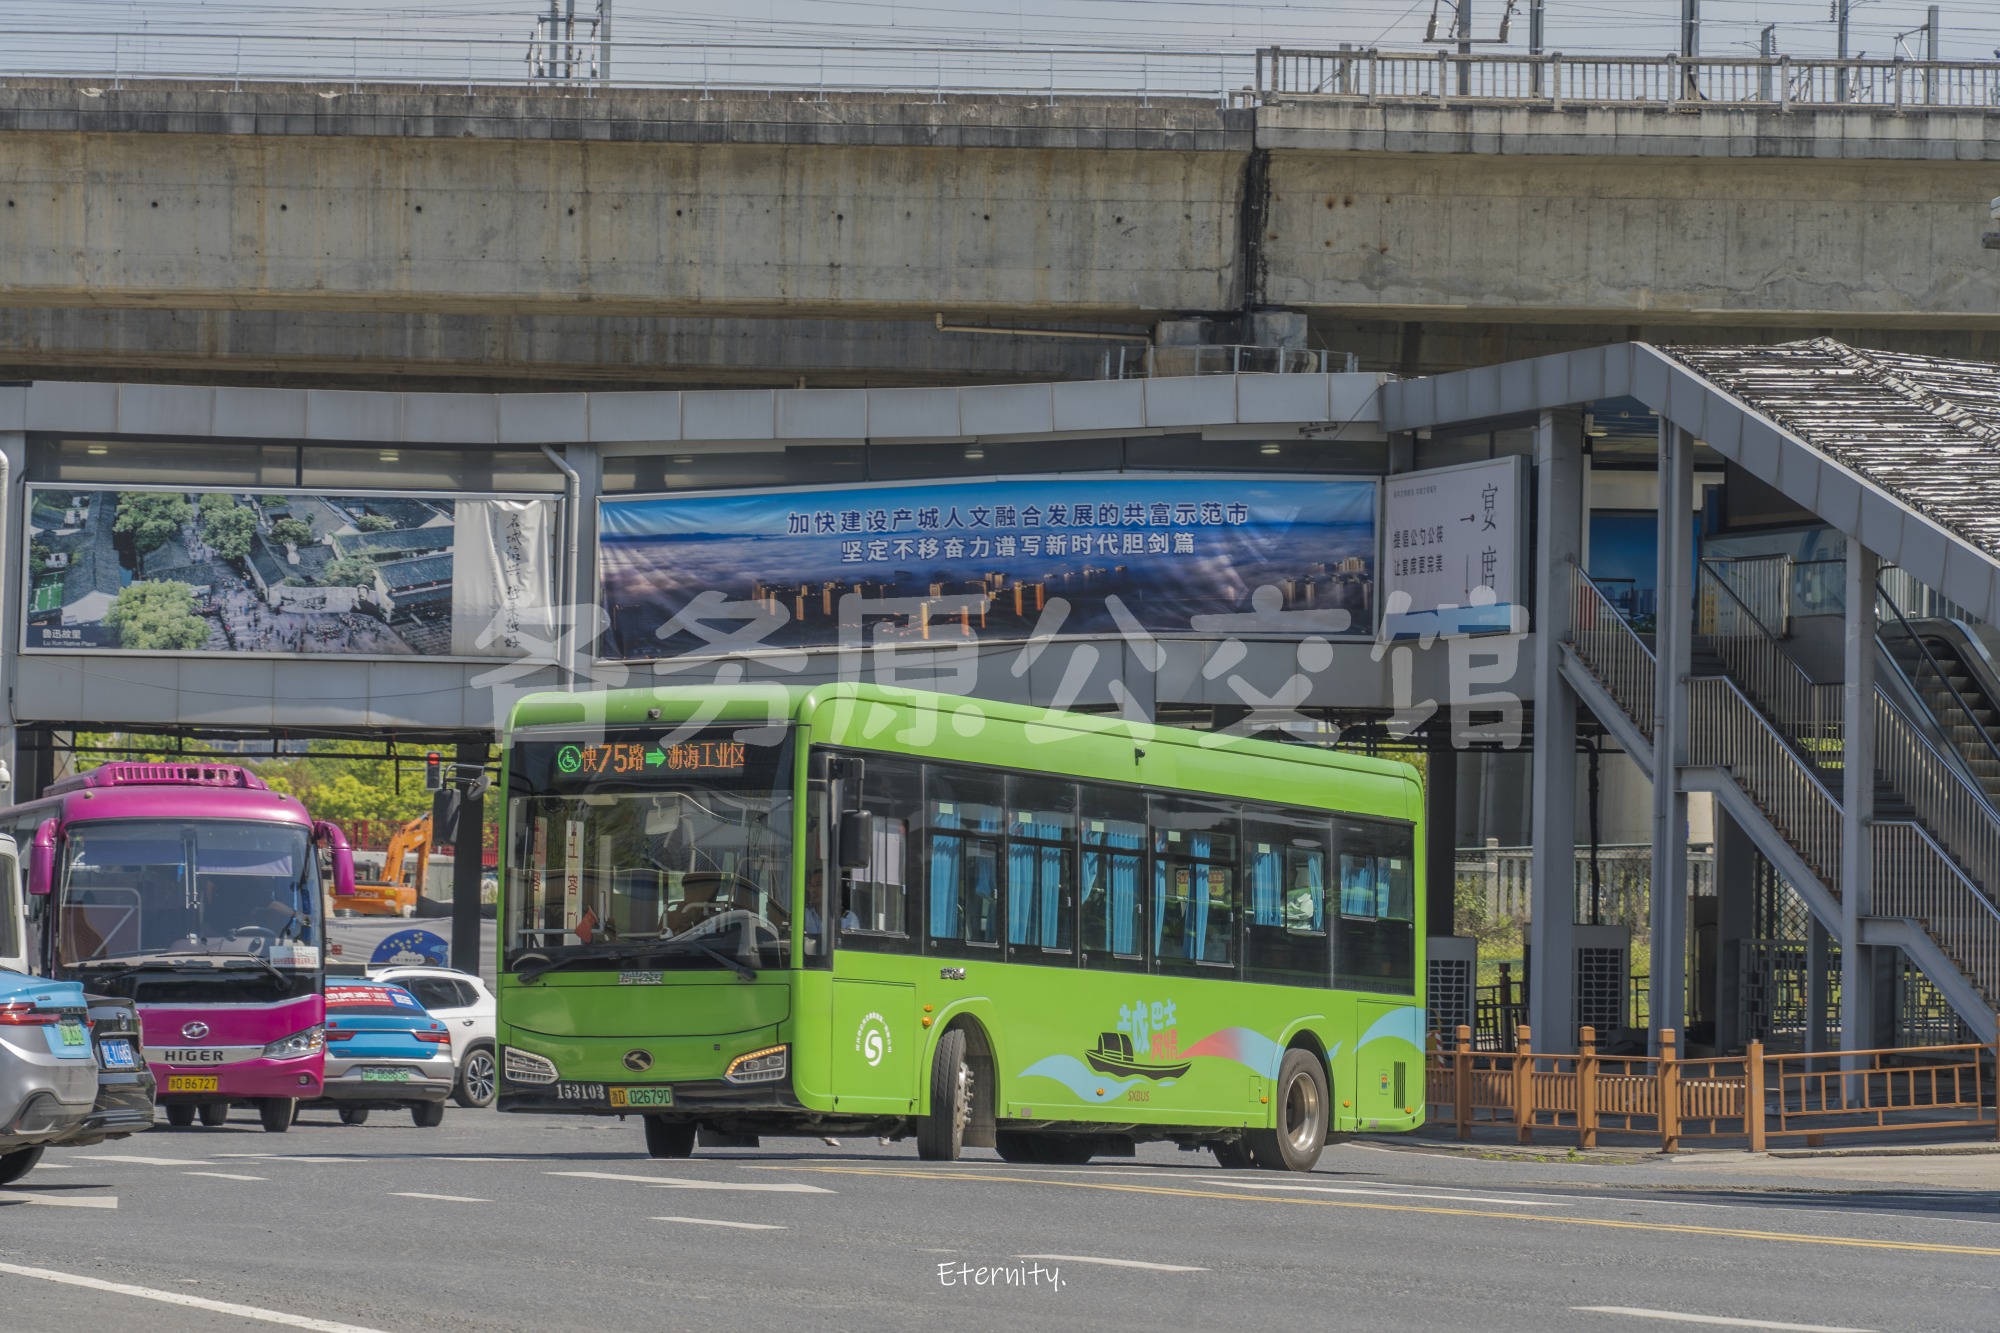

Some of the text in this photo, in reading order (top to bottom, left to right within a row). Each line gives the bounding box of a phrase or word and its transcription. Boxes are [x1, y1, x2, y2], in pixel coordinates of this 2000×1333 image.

[787, 502, 1249, 535] 加快建设产城人文融合发展的共富示范市
[840, 532, 1195, 563] 坚定不移奋力谱写新时代胆剑篇
[43, 629, 81, 639] 鲁迅故里
[165, 1050, 224, 1062] HIGER
[556, 1083, 605, 1100] 153103
[1128, 1090, 1150, 1102] SXBUS
